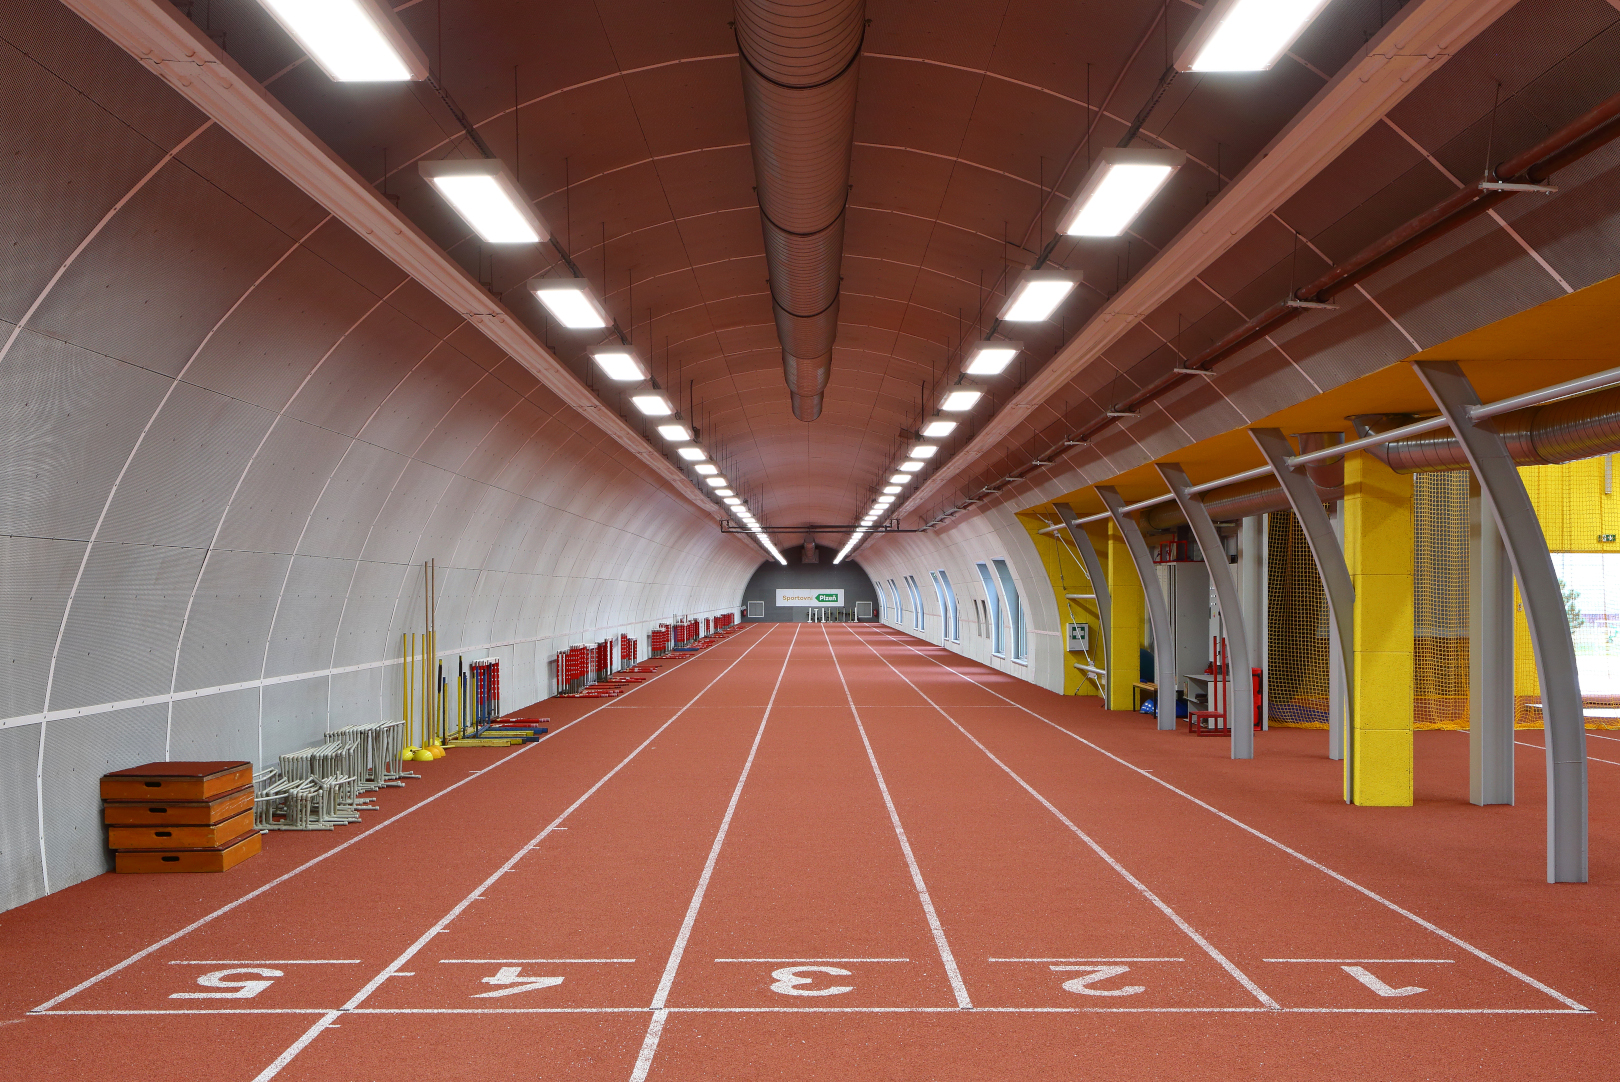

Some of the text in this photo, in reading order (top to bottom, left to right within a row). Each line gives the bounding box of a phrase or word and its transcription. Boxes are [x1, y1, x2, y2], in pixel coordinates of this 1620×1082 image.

[168, 969, 285, 1001] 5
[469, 966, 566, 999] 4
[769, 965, 854, 997] 3
[1049, 964, 1146, 998] 2
[1341, 966, 1429, 997] 1
